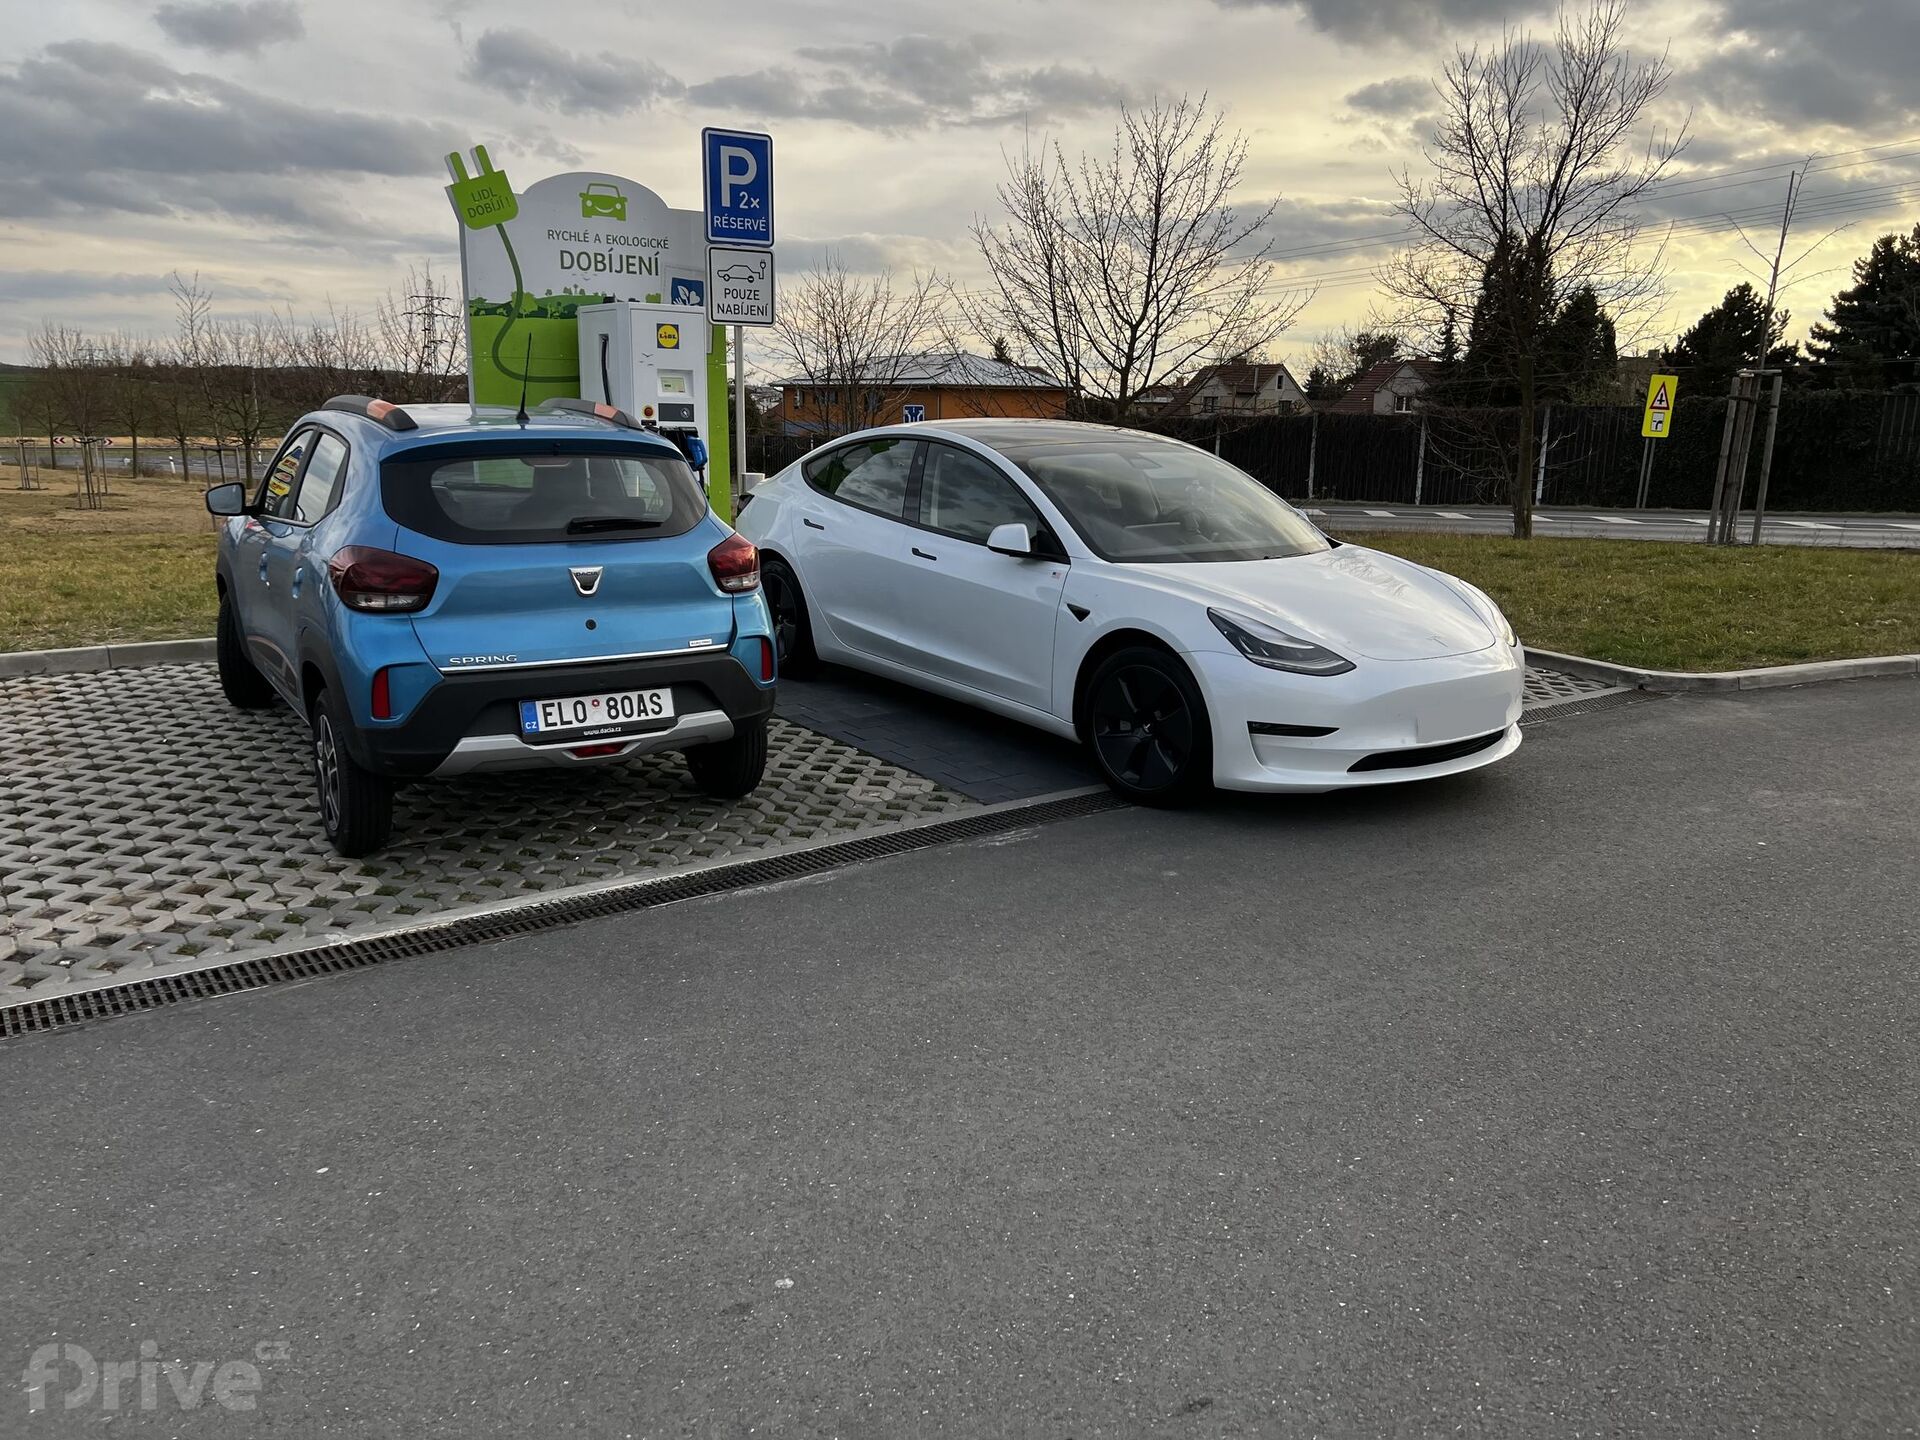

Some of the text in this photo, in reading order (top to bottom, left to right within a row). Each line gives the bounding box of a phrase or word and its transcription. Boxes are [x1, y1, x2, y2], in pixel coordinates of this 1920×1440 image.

[720, 145, 758, 208] P
[471, 186, 498, 202] LIDL
[739, 191, 760, 209] 2x
[713, 213, 767, 232] RÉSERVÉ
[547, 229, 670, 250] RYCHLÉ A EKOLOGICKÉ
[560, 247, 660, 277] DOBÍJENÍ
[724, 287, 760, 301] POUZE
[717, 301, 769, 317] NABÍJENÍ
[449, 654, 518, 665] SPRING
[605, 692, 663, 720] 80AS
[525, 720, 538, 730] CZ
[583, 726, 622, 736] www.dacia.cz
